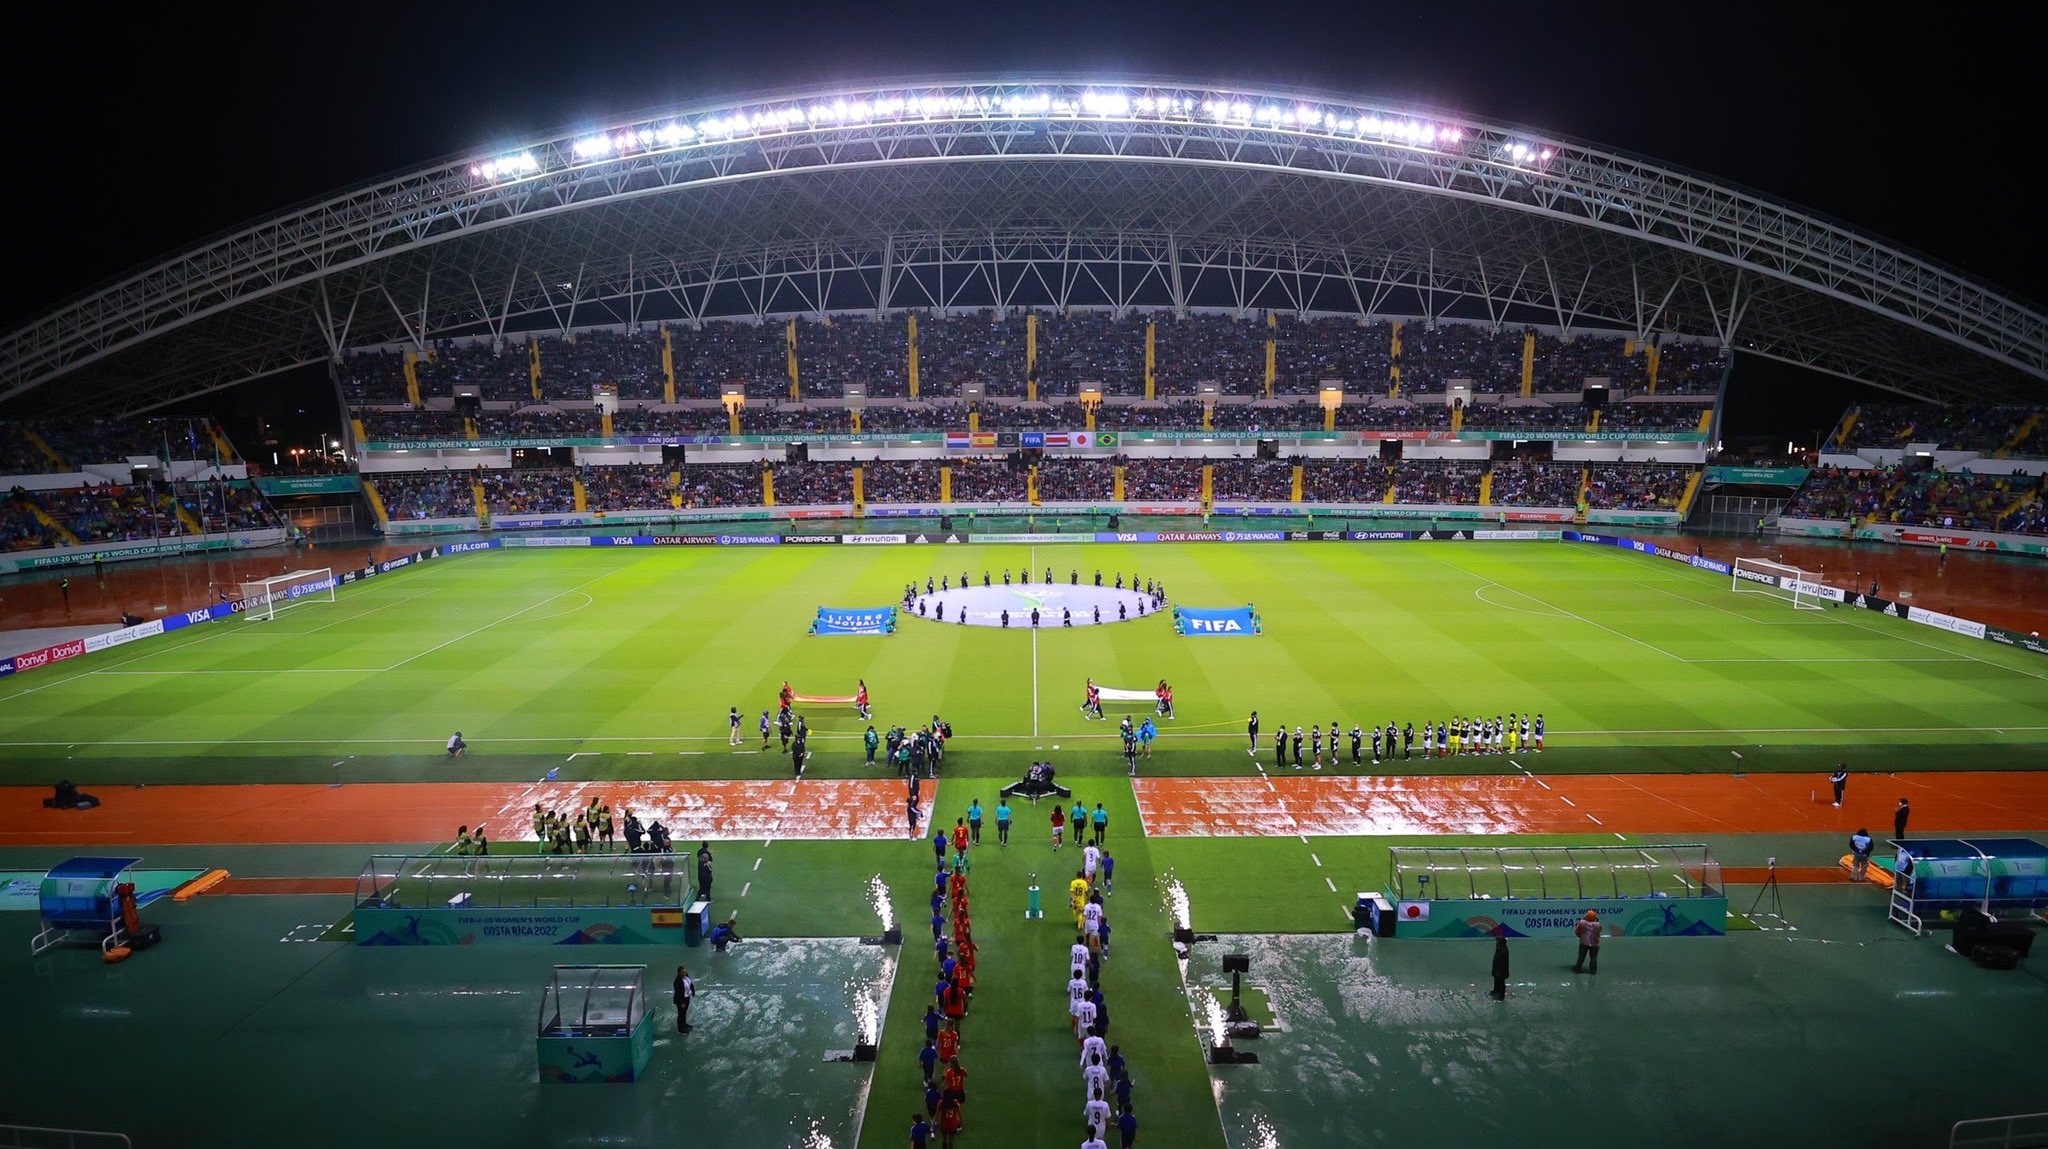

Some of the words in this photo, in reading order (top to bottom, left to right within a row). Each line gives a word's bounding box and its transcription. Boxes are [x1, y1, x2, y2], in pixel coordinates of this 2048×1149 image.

[388, 442, 408, 450] FIFA
[428, 441, 469, 449] WOMEN'S
[611, 537, 634, 545] VISA
[653, 537, 680, 545] QATAR
[683, 536, 718, 545] AIRWAYS
[747, 536, 775, 544] WANDA
[1117, 533, 1138, 542] VISA
[1157, 533, 1185, 542] QATAR
[1186, 533, 1222, 541] AIRWAYS
[451, 540, 490, 553] FIFA.com
[1633, 541, 1645, 552] VISA
[34, 558, 51, 566] FIFA
[51, 555, 70, 564] U-20
[110, 548, 140, 557] WORLD
[140, 546, 156, 554] CUP
[1655, 547, 1671, 558] QATAR
[390, 557, 409, 568] HYUNDAI
[1802, 583, 1837, 598] HYUNDAI
[231, 596, 258, 613] QATAR
[186, 608, 211, 624] VISA
[1191, 618, 1242, 632] FIFA
[1087, 910, 1097, 920] 12
[1525, 918, 1552, 928] COSTA
[484, 926, 511, 936] COSTA
[534, 926, 557, 936] 2022
[1074, 953, 1083, 964] 10
[1073, 988, 1083, 1000] 16
[1082, 1011, 1091, 1023] 11
[943, 1038, 952, 1048] 20
[1094, 1112, 1101, 1125] 9
